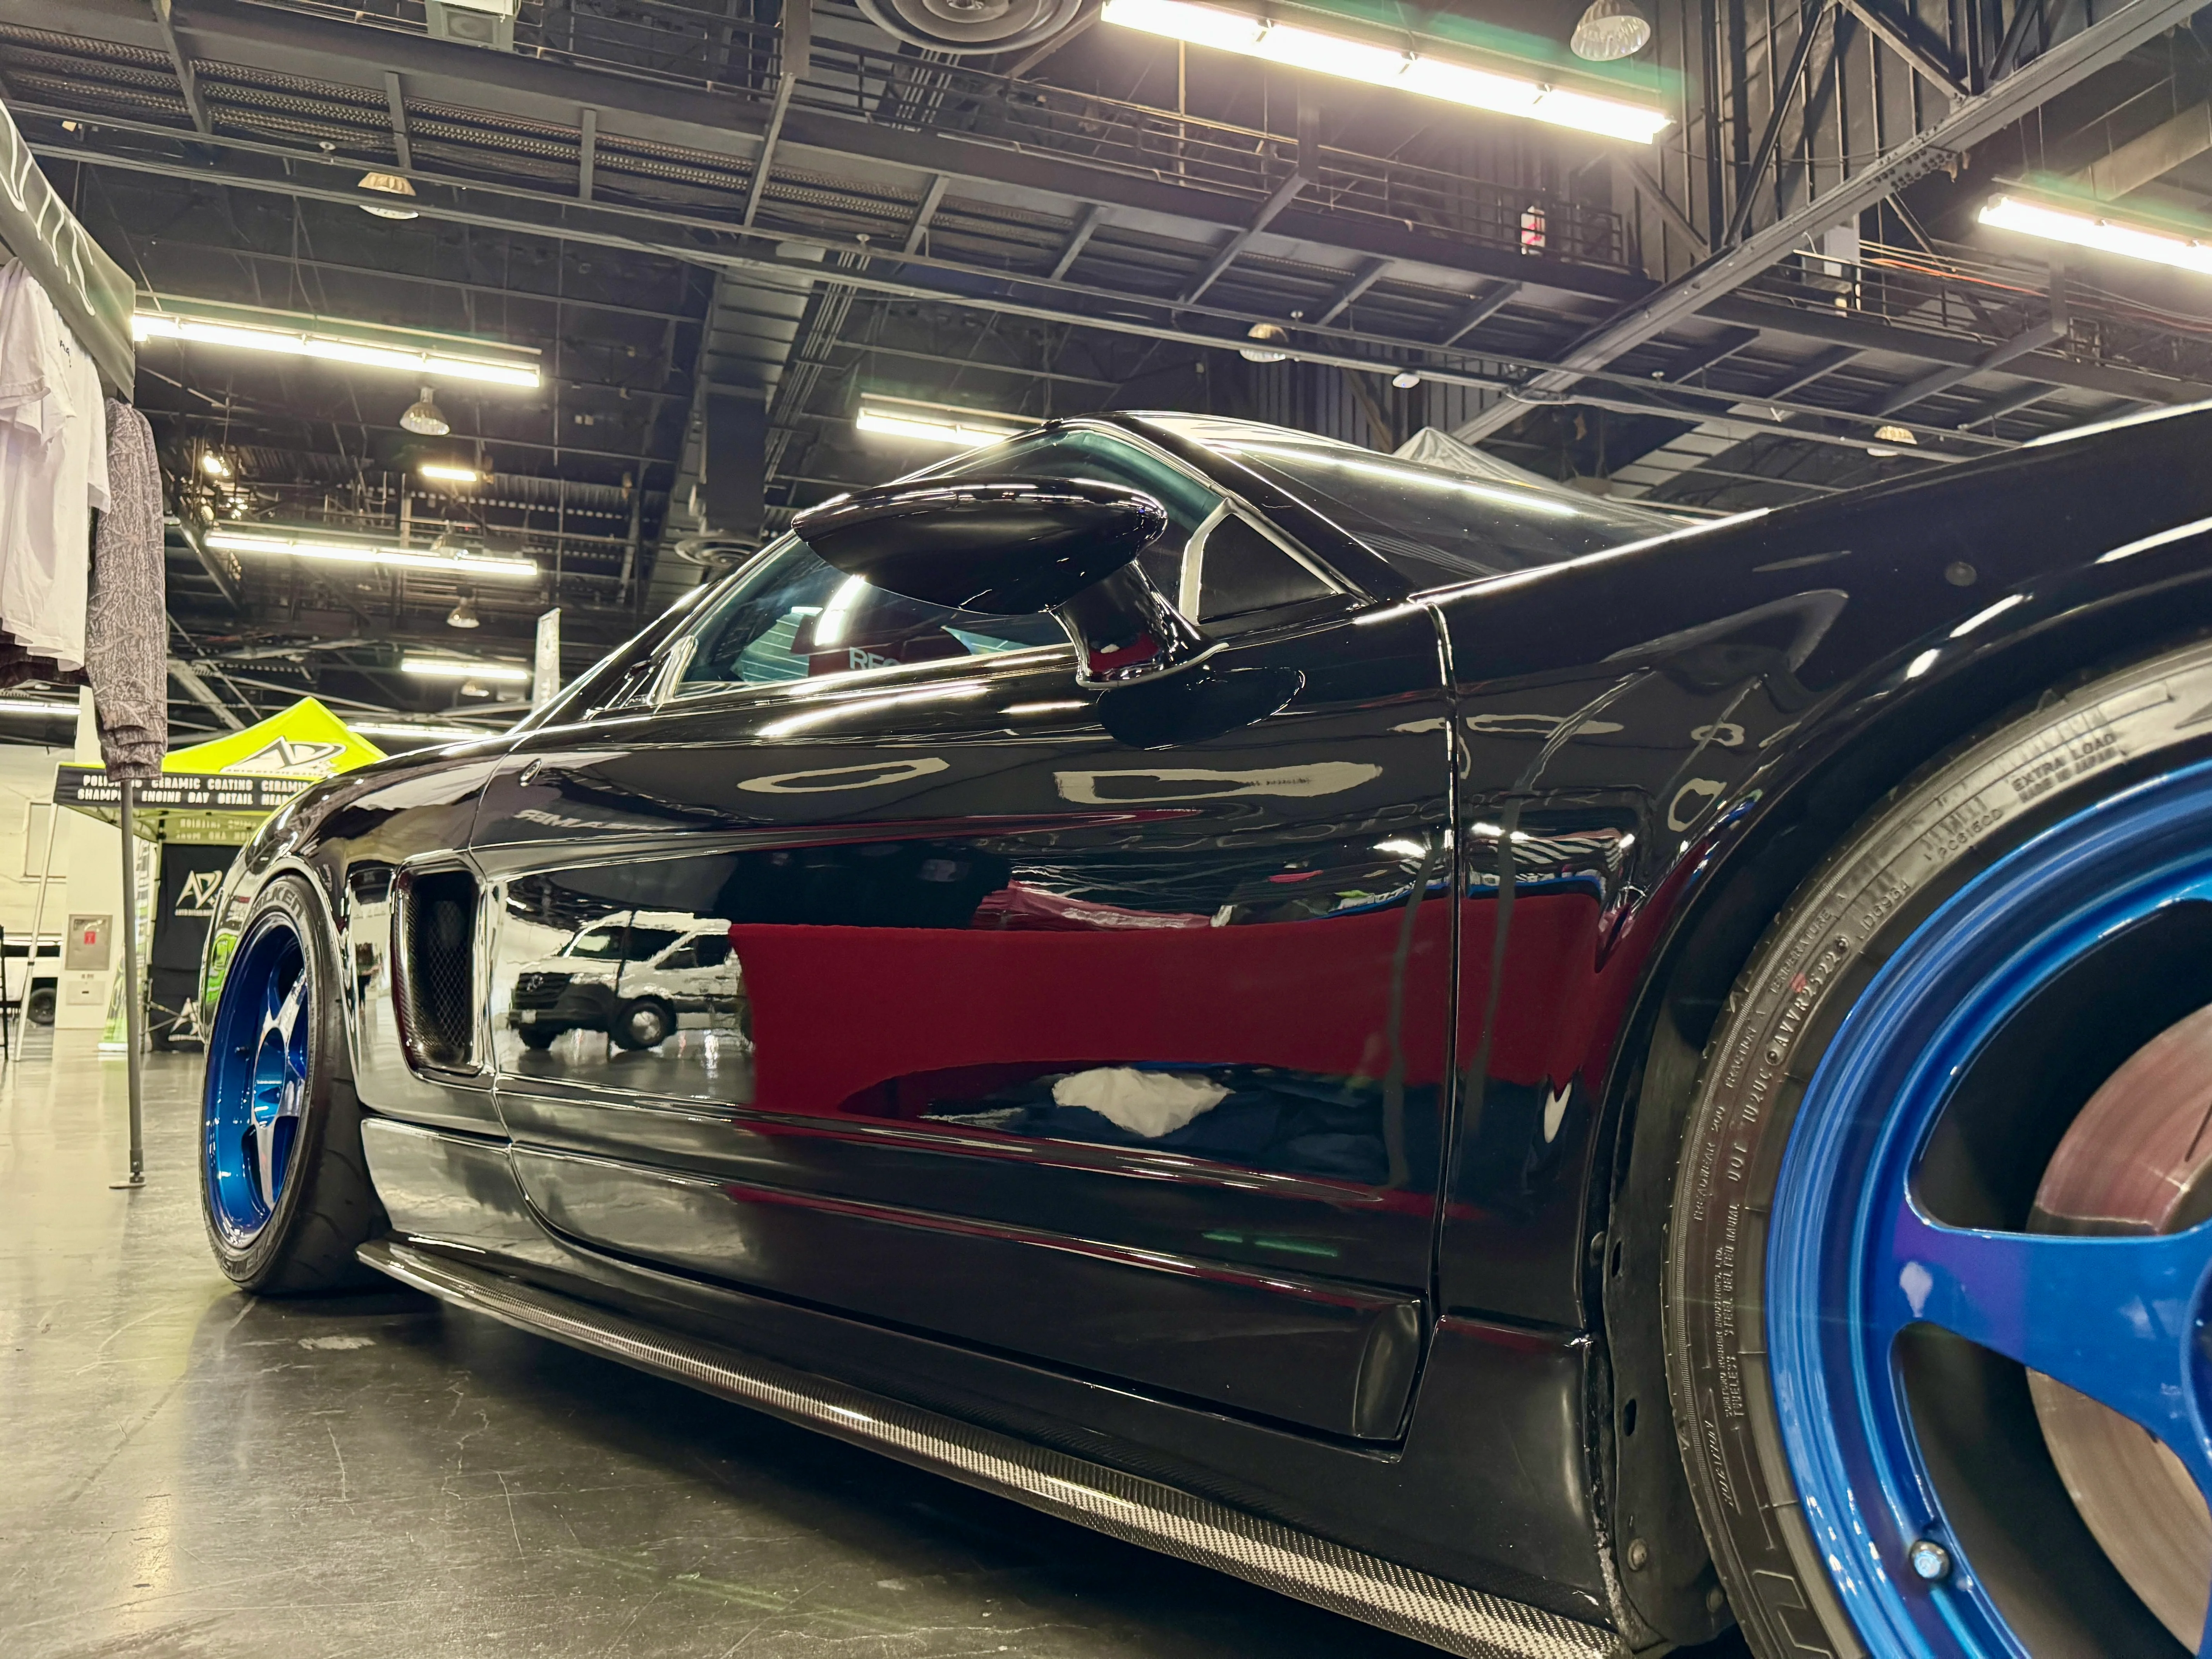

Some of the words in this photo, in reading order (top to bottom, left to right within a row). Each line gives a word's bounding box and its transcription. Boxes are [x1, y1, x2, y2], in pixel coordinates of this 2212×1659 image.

[2012, 756, 2067, 792] EXTRA
[2069, 733, 2117, 760] LOAD
[141, 790, 181, 803] ENGINE
[217, 793, 253, 805] DETAIL
[151, 777, 201, 789] CERAMIC
[207, 778, 253, 791] COATING
[252, 886, 305, 921] ALKEN
[1727, 1142, 1748, 1182] DOT
